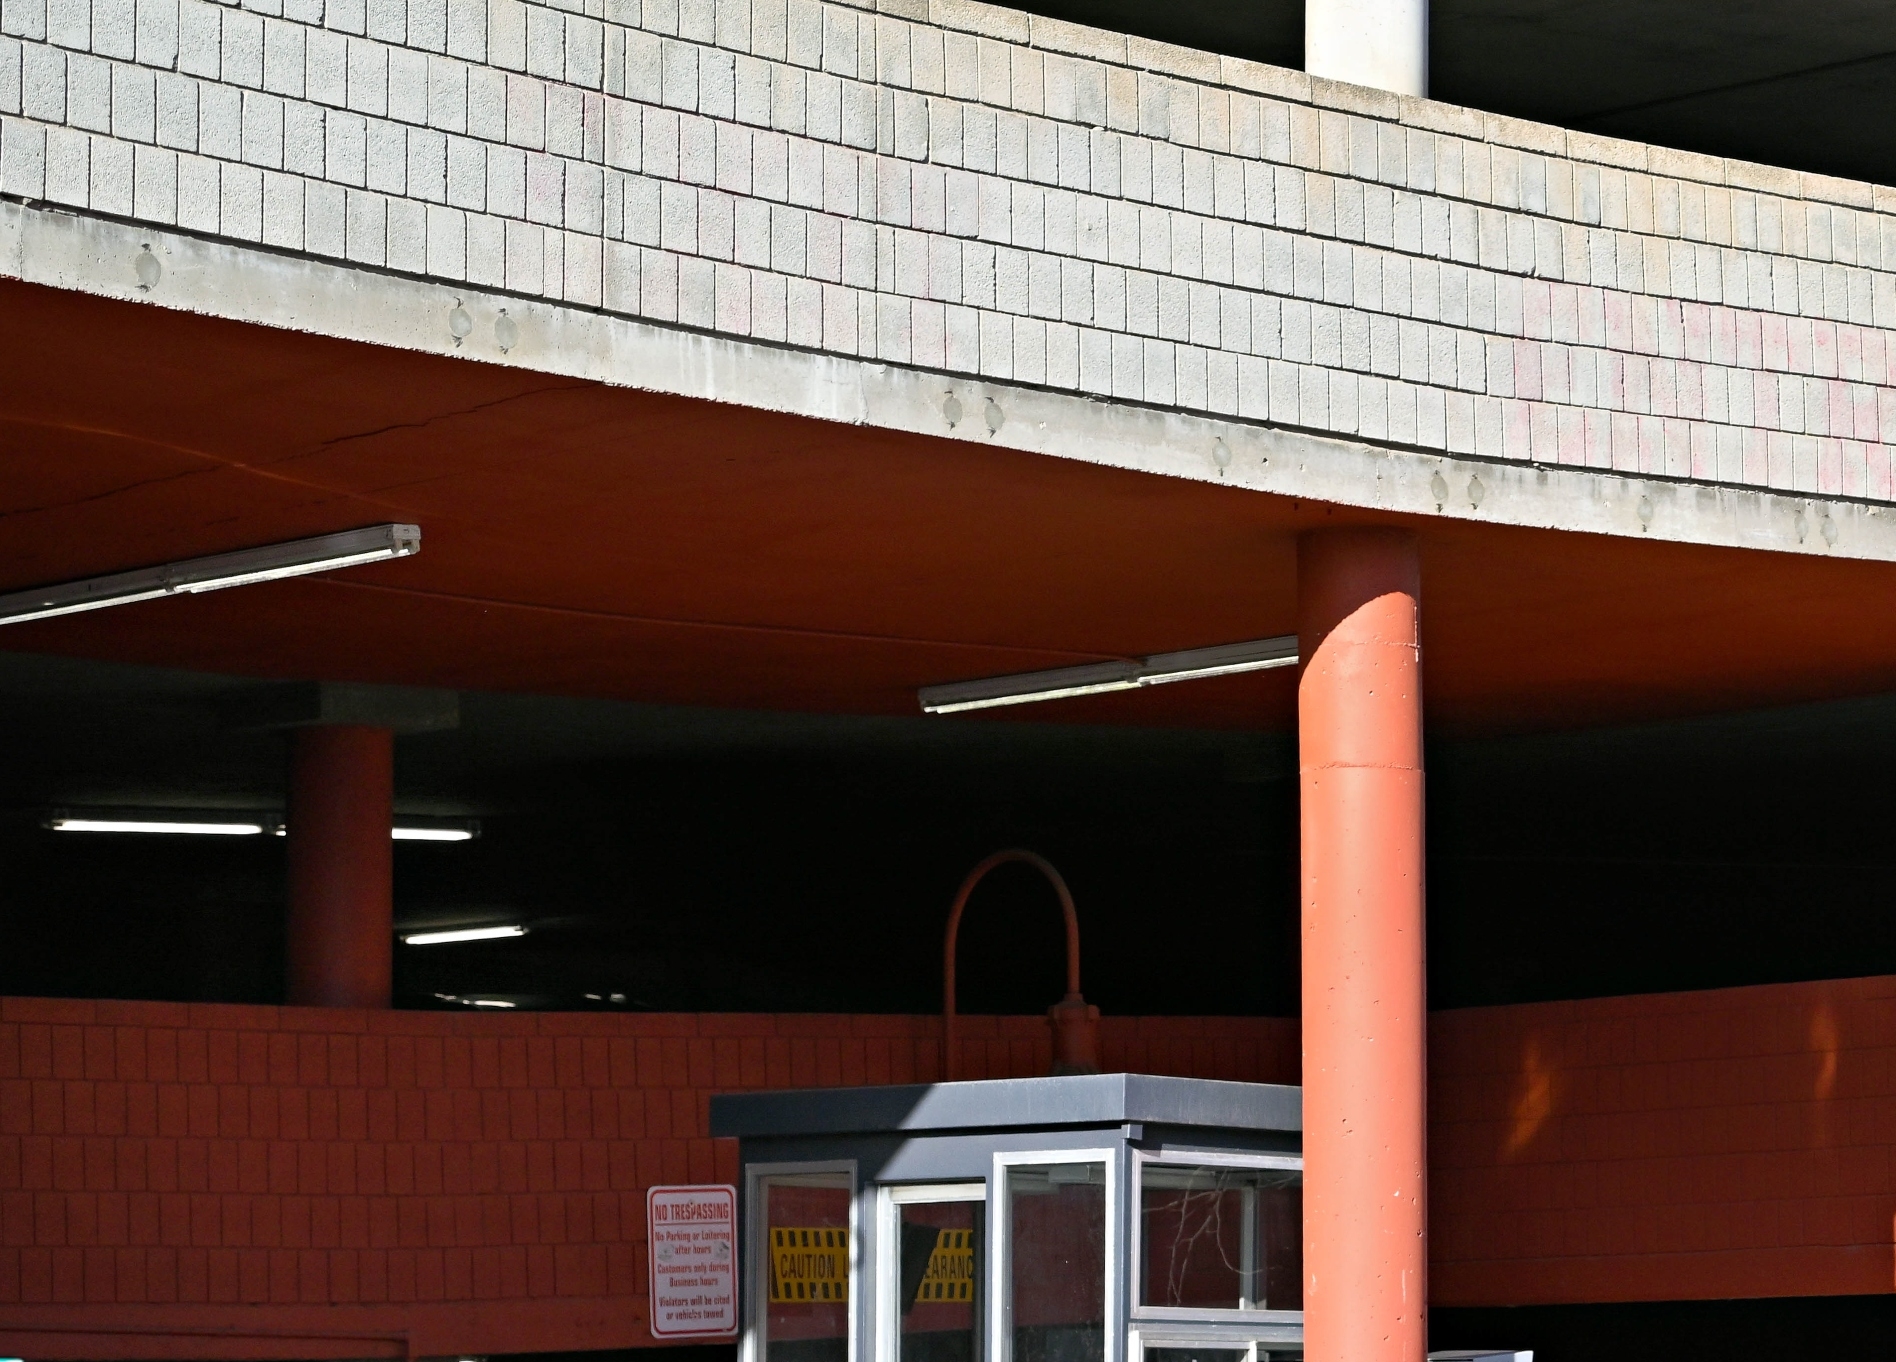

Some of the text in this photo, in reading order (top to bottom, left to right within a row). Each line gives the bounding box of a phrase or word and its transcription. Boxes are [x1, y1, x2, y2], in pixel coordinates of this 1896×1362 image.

[655, 1202, 729, 1220] NO TRESPASSING
[655, 1231, 664, 1241] No
[666, 1230, 690, 1242] Parking
[701, 1230, 730, 1242] Loitering
[675, 1244, 712, 1254] after hours
[658, 1262, 730, 1274] Customers only during
[780, 1253, 835, 1278] CAUTION
[669, 1276, 718, 1287] Business hours
[659, 1294, 730, 1307] Violators will be cited
[666, 1308, 724, 1320] or vehicles towed
